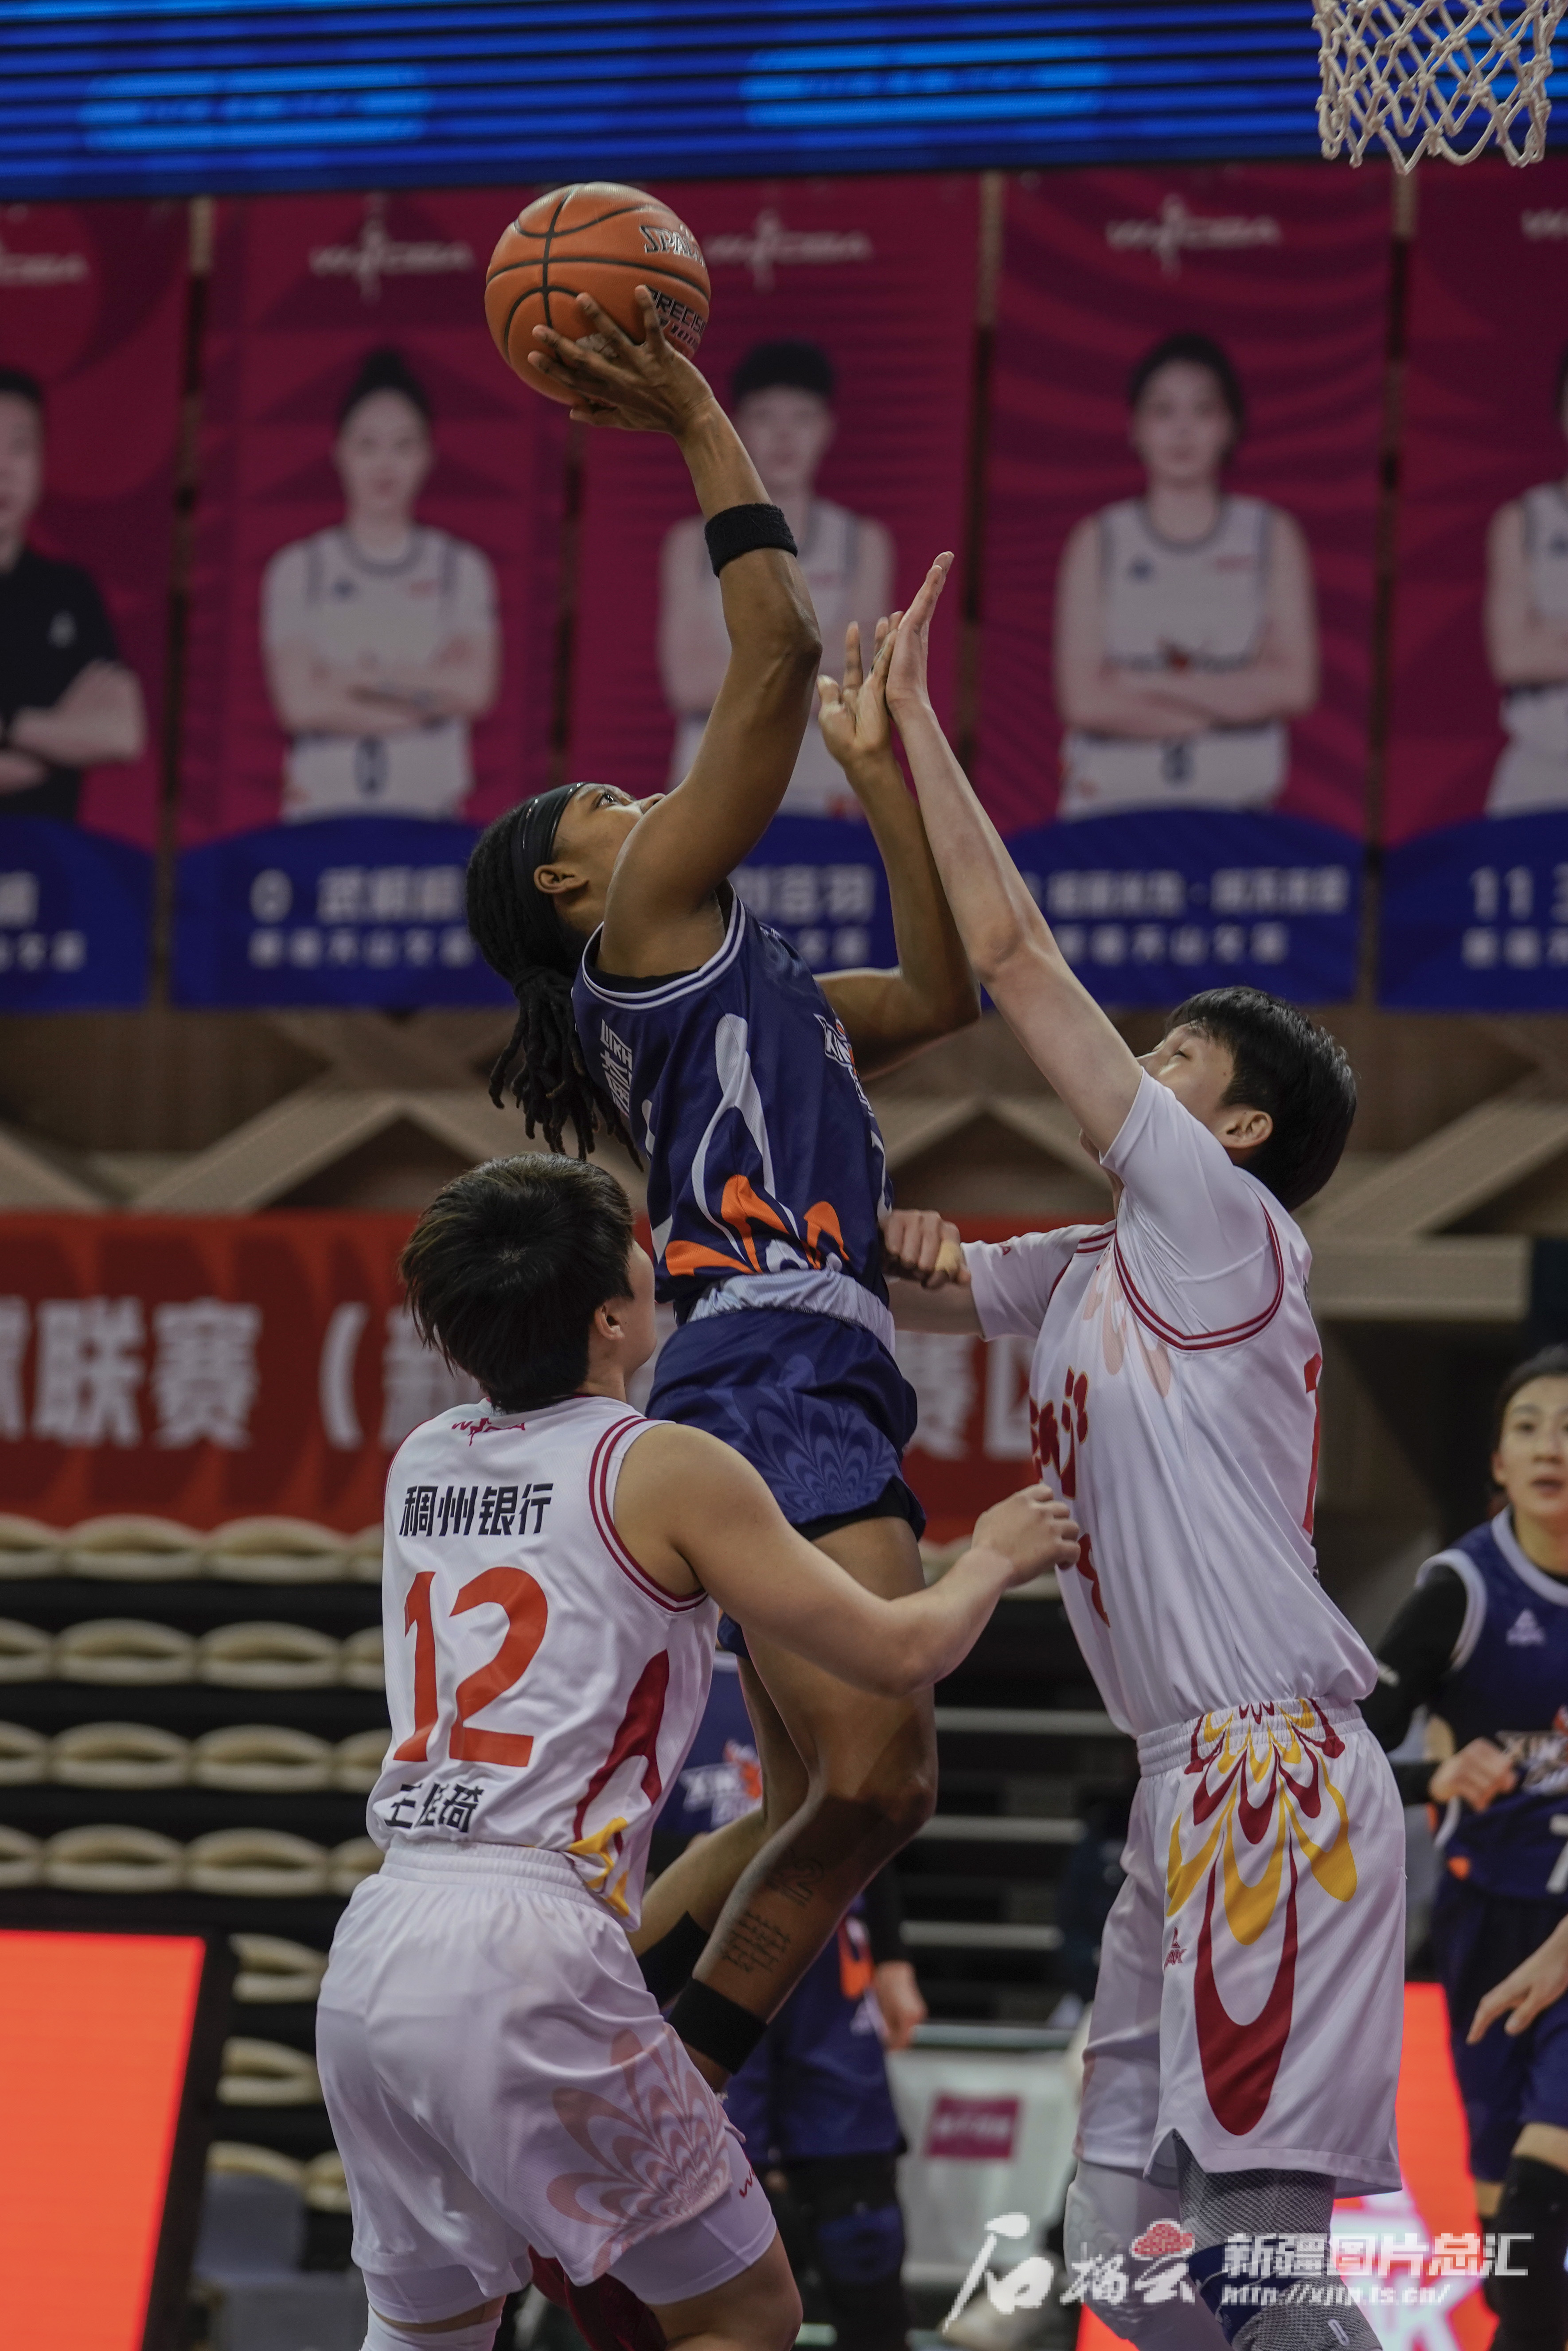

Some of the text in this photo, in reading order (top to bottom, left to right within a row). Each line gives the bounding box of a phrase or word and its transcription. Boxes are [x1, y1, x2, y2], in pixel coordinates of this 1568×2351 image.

[399, 1483, 554, 1536] 稠州银行
[393, 1566, 548, 1767] 12
